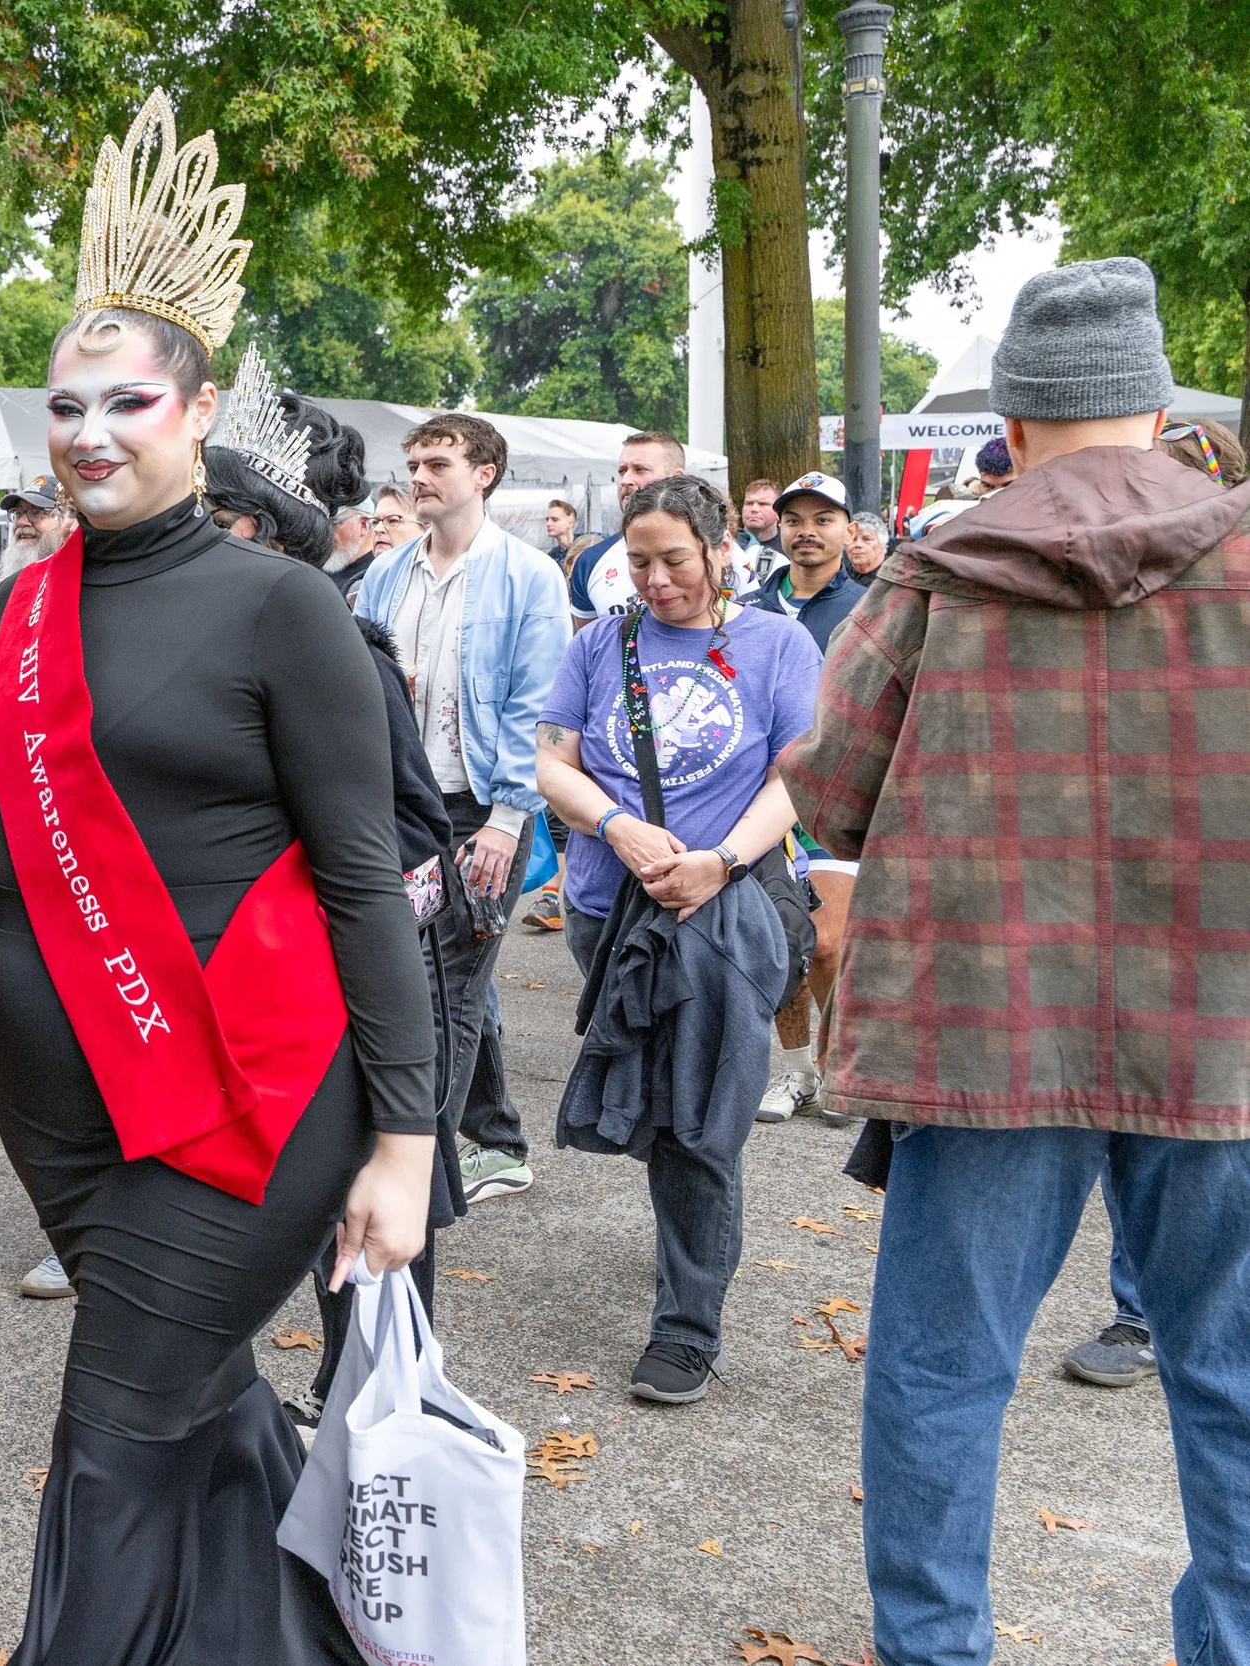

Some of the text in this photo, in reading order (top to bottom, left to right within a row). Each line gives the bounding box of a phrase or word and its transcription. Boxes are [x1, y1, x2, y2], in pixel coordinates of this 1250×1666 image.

[908, 424, 1004, 437] WELCOME
[18, 637, 40, 704] HIV
[606, 715, 625, 764] PARADE
[713, 688, 744, 768] WATERFRONT
[23, 729, 109, 934] Awareness
[104, 947, 172, 1044] PDX
